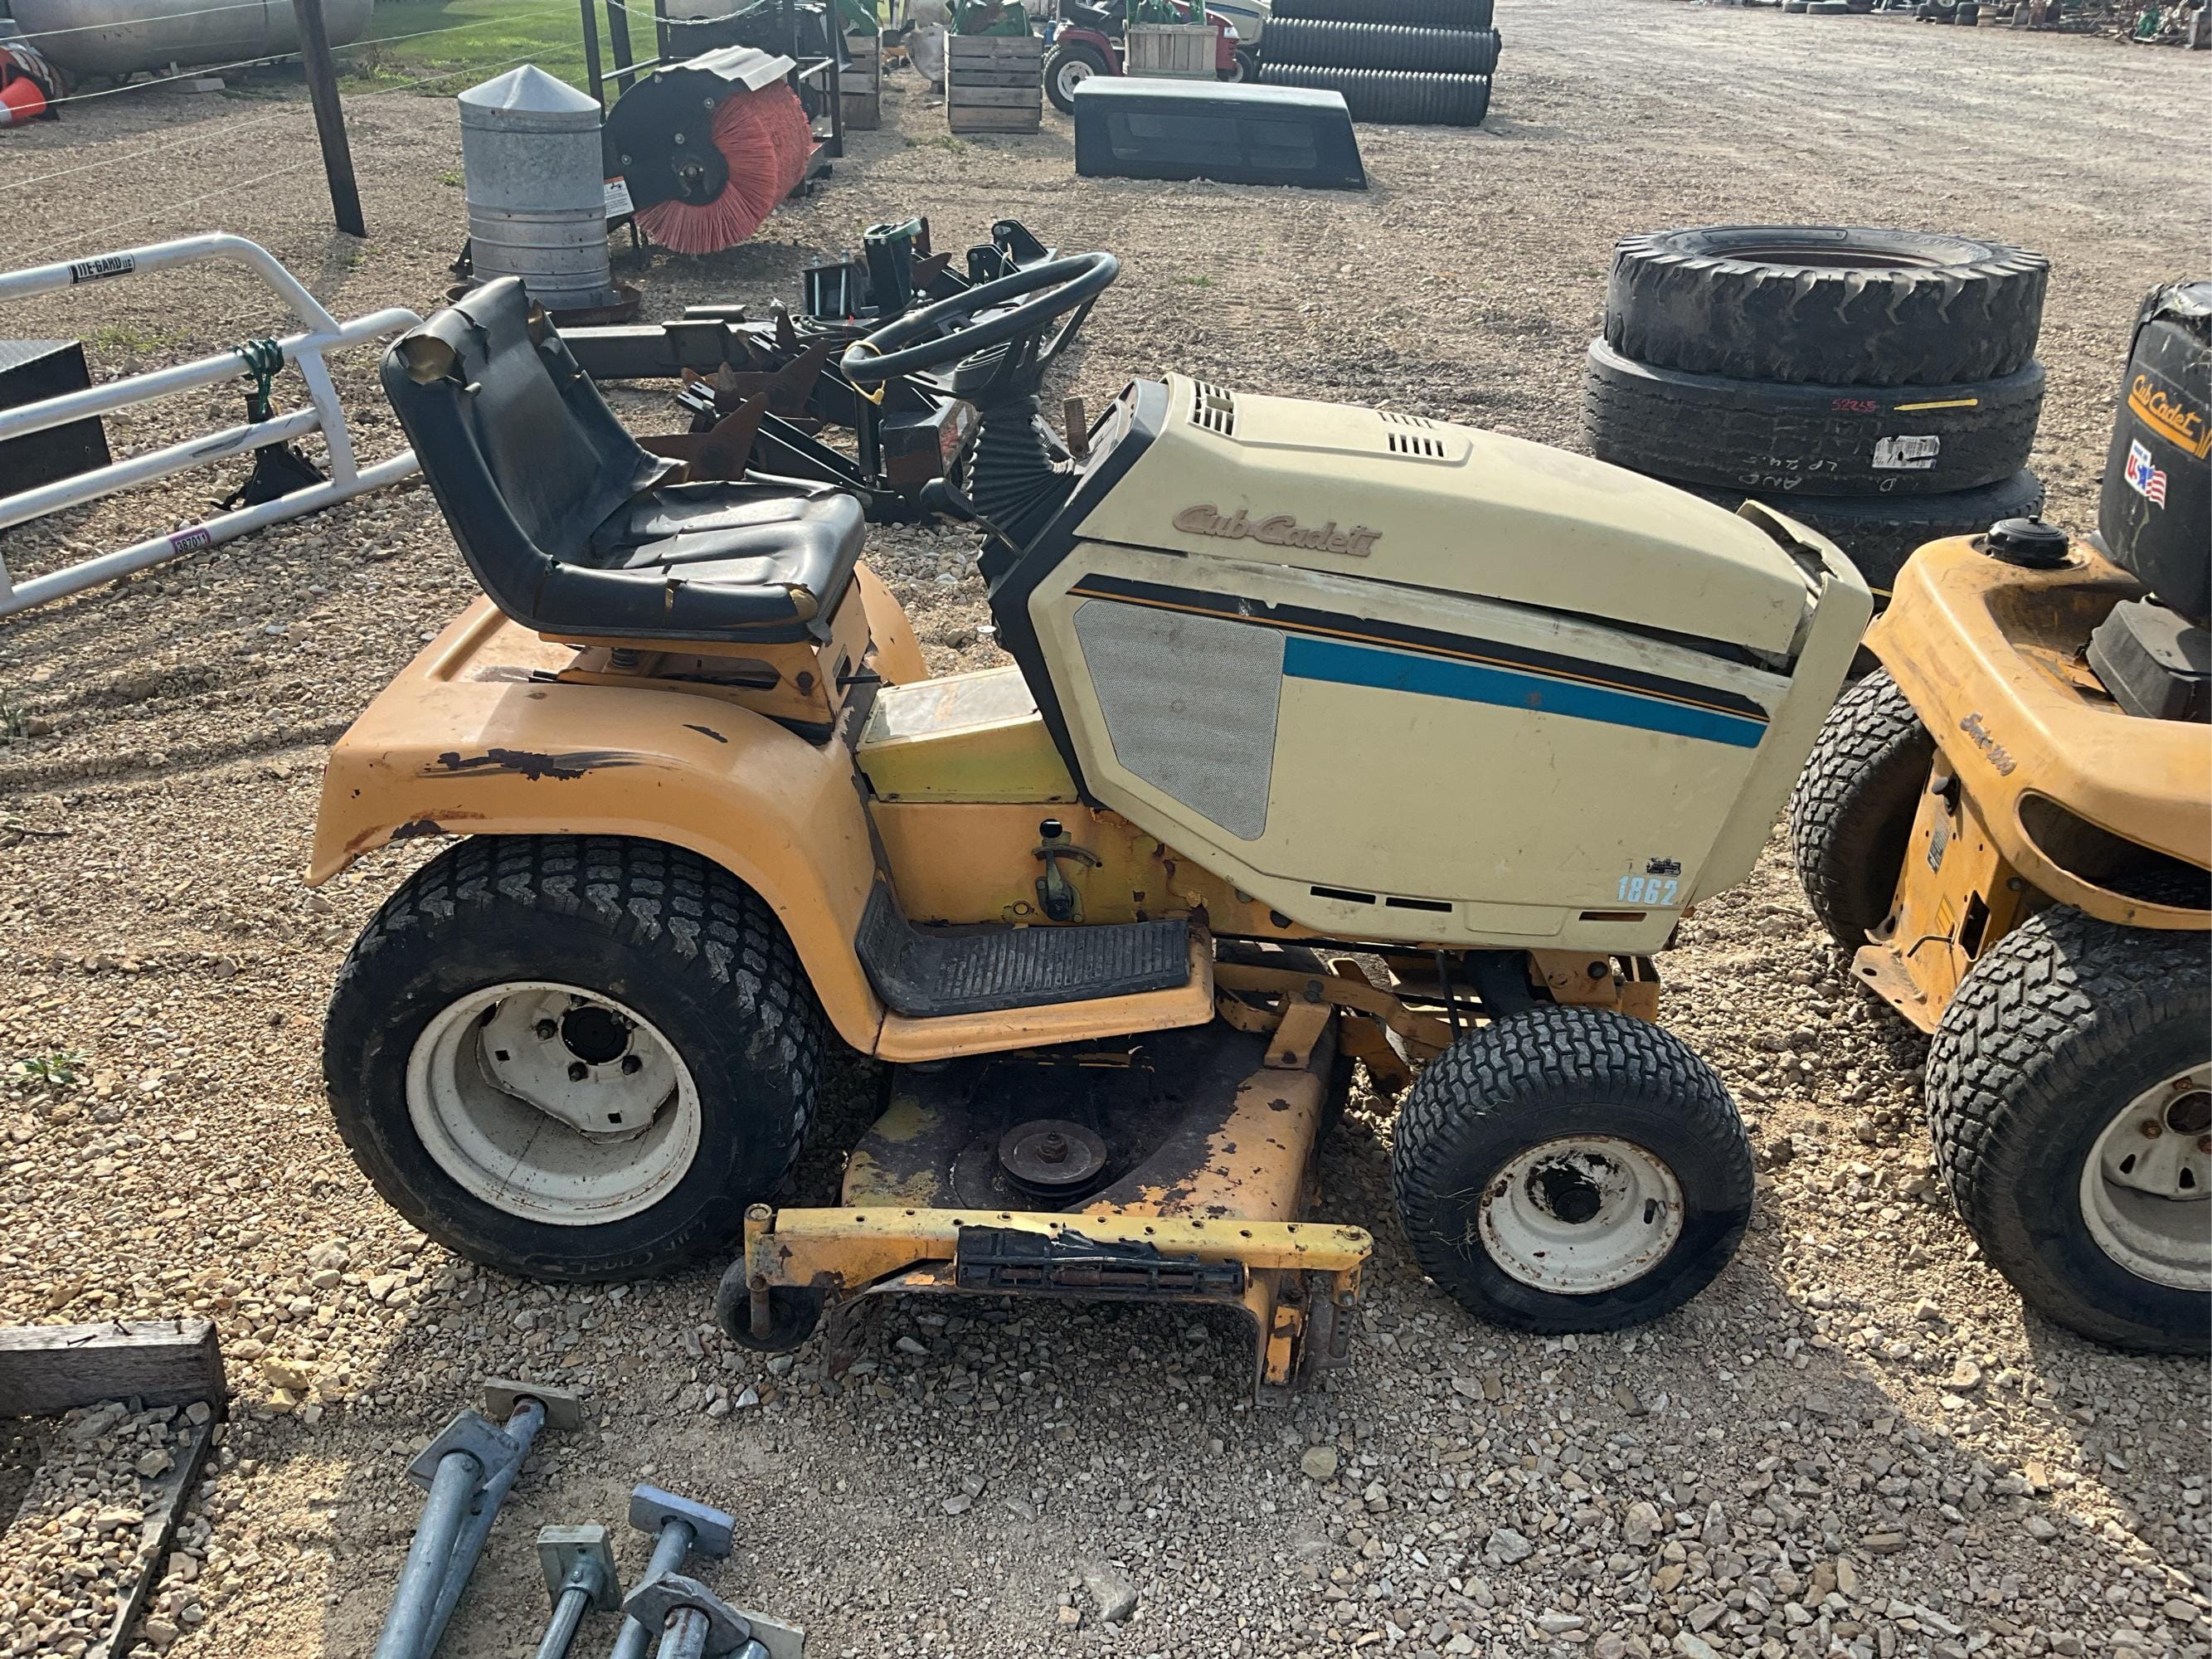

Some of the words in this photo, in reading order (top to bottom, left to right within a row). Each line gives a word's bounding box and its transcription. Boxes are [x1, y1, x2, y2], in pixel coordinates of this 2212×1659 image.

[2132, 373, 2154, 406] Cub
[2149, 391, 2203, 437] Cadet
[177, 533, 207, 552] 387011
[1172, 501, 1250, 540] Cub
[1252, 513, 1383, 558] Cadet
[1616, 874, 1679, 907] 1862
